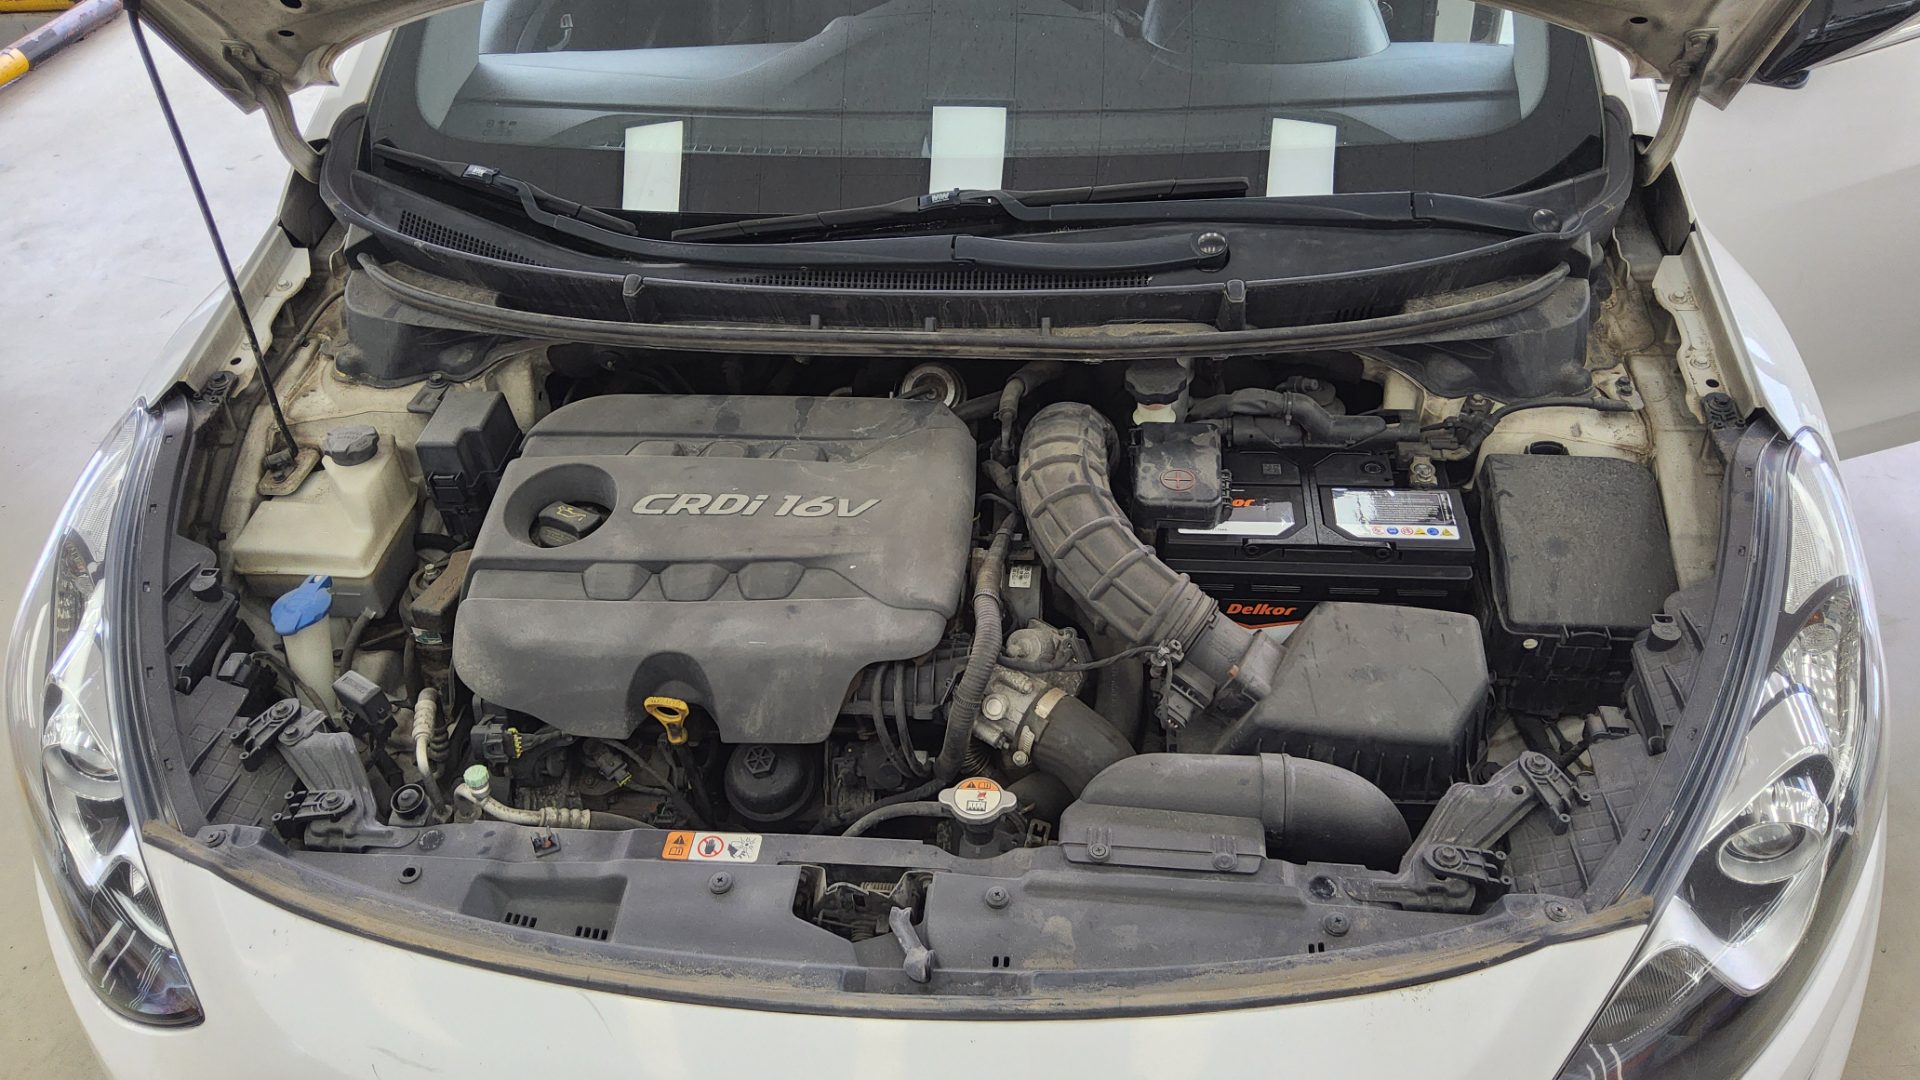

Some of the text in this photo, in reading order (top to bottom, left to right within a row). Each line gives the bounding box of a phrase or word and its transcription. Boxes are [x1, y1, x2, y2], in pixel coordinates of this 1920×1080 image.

[631, 493, 881, 518] CRDi 16V
[1226, 603, 1297, 616] Delkor
